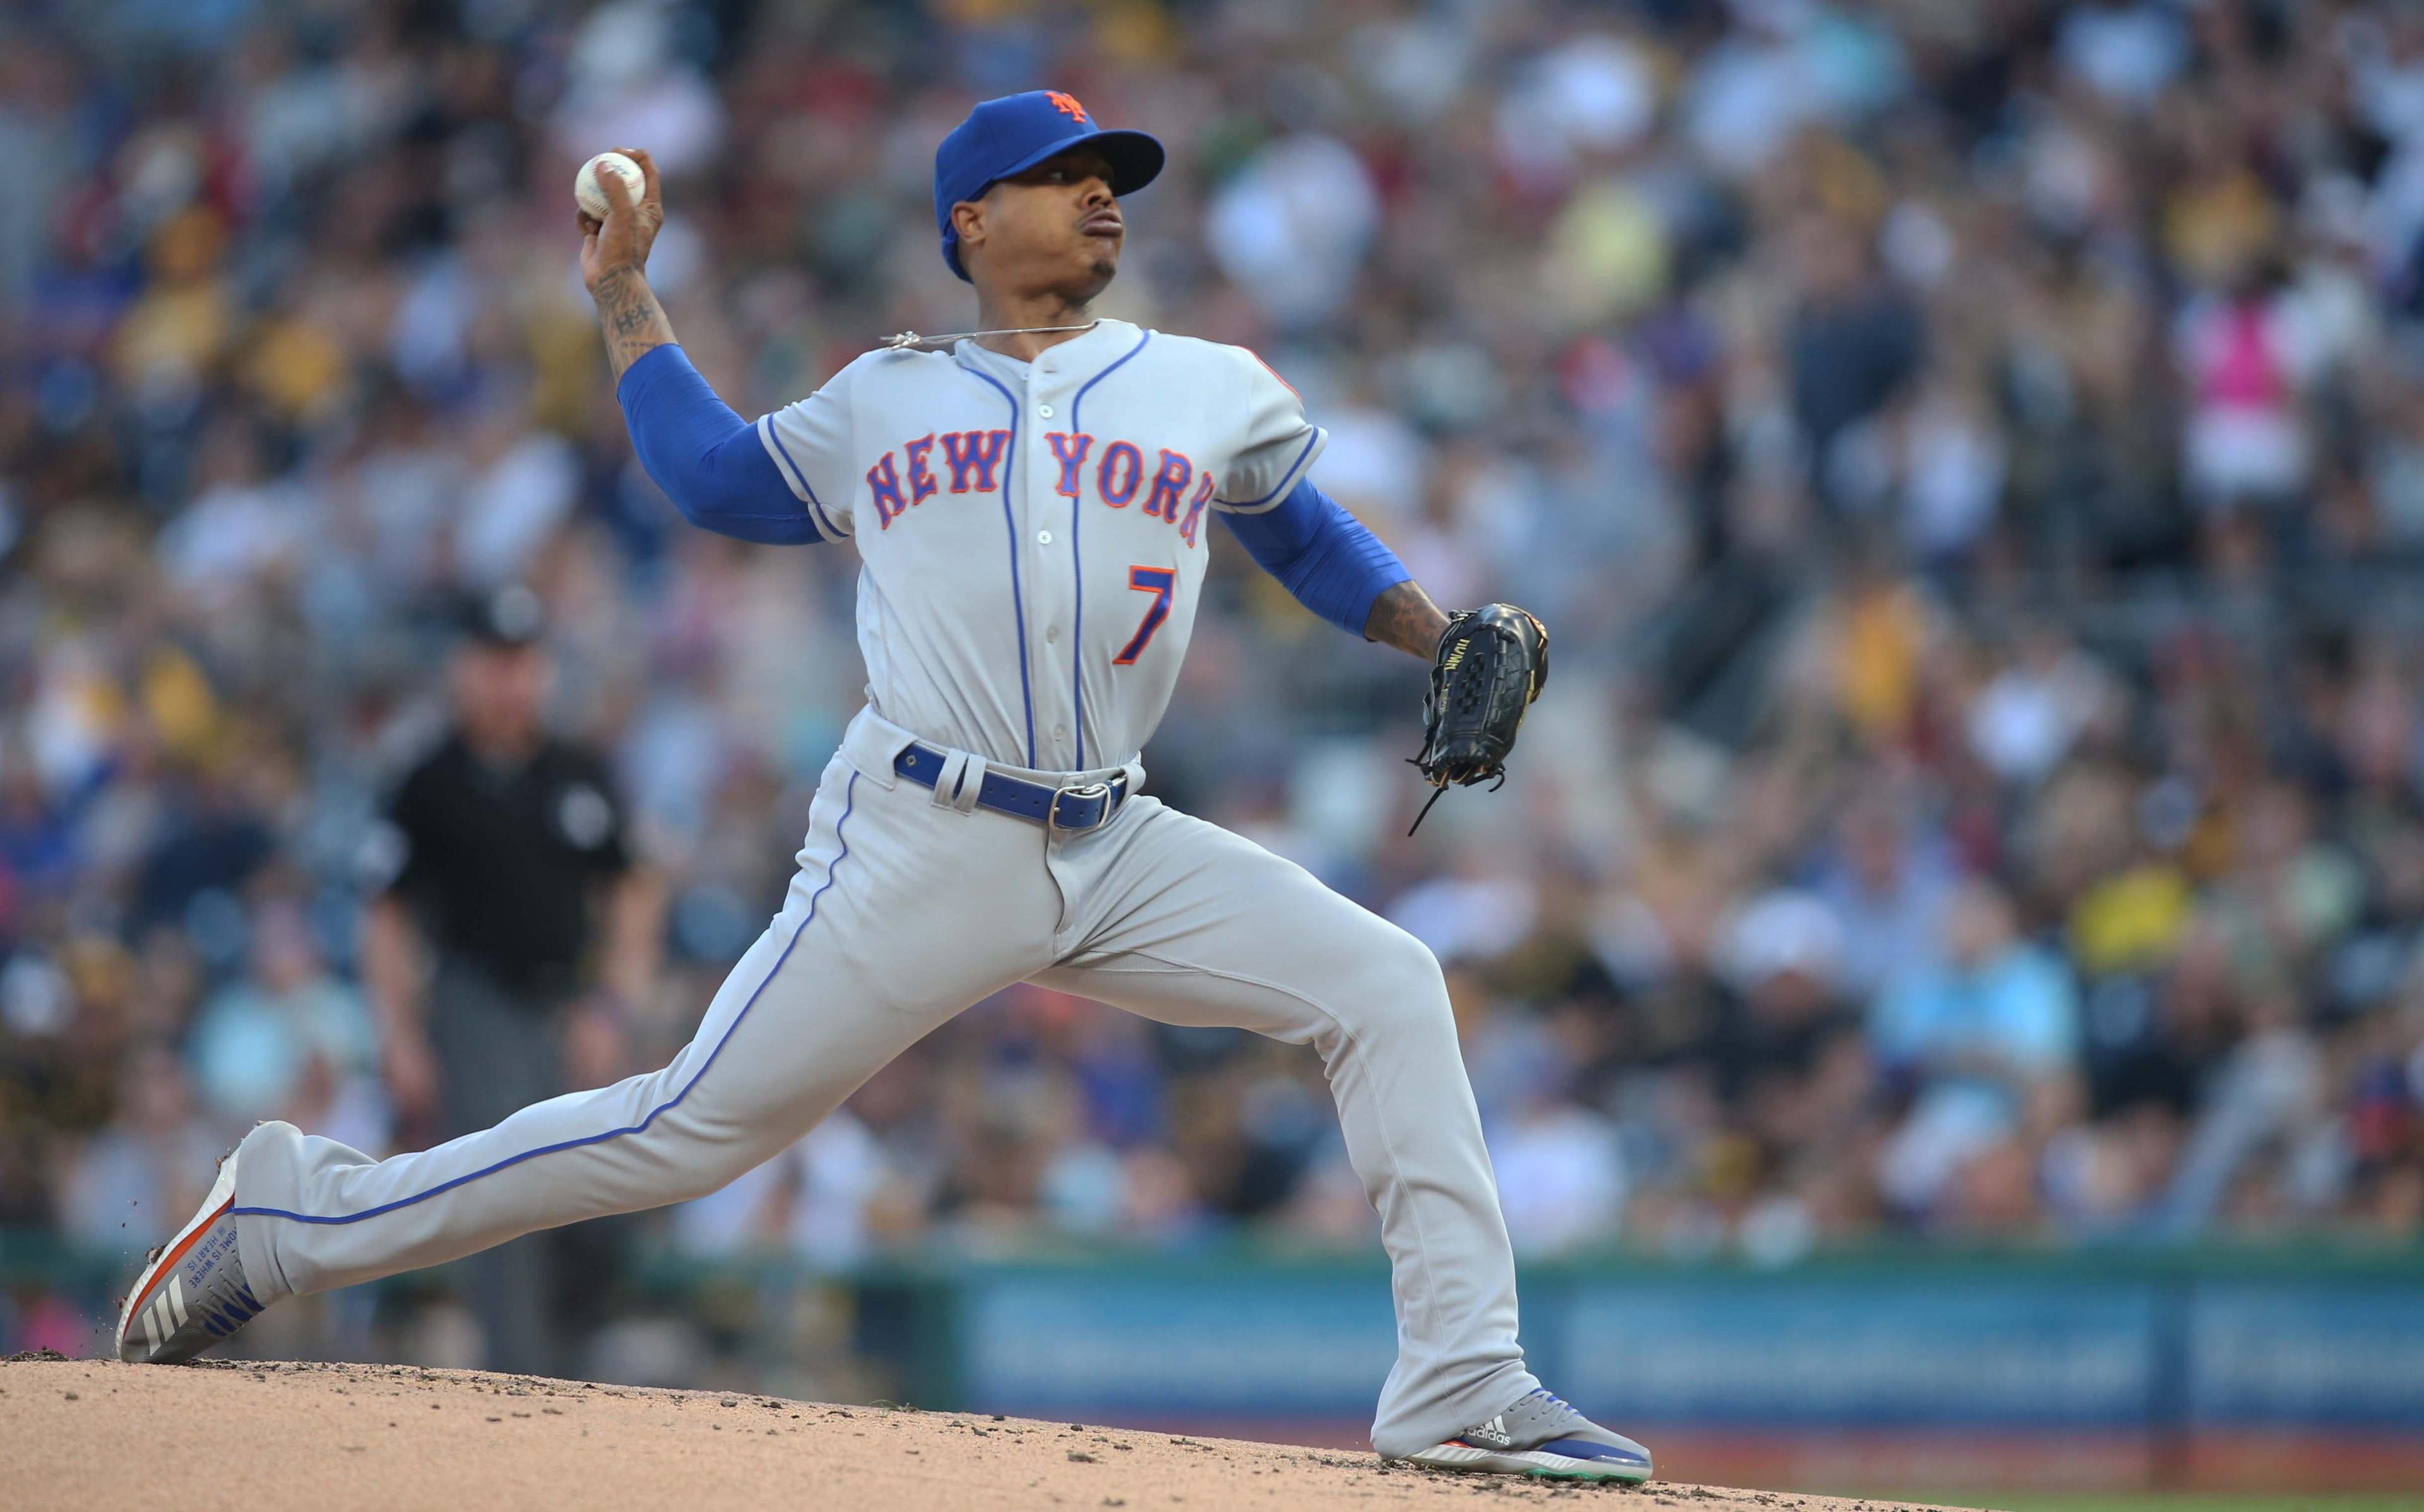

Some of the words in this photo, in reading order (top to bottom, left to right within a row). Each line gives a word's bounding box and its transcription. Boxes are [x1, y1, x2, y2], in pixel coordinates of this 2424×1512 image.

[867, 430, 1012, 529] NEW
[1045, 432, 1215, 548] YORK
[1113, 565, 1175, 665] 7
[196, 1235, 218, 1261] HEART
[211, 1249, 222, 1260] IS
[188, 1260, 215, 1288] WHERE
[1468, 1426, 1511, 1445] adidas
